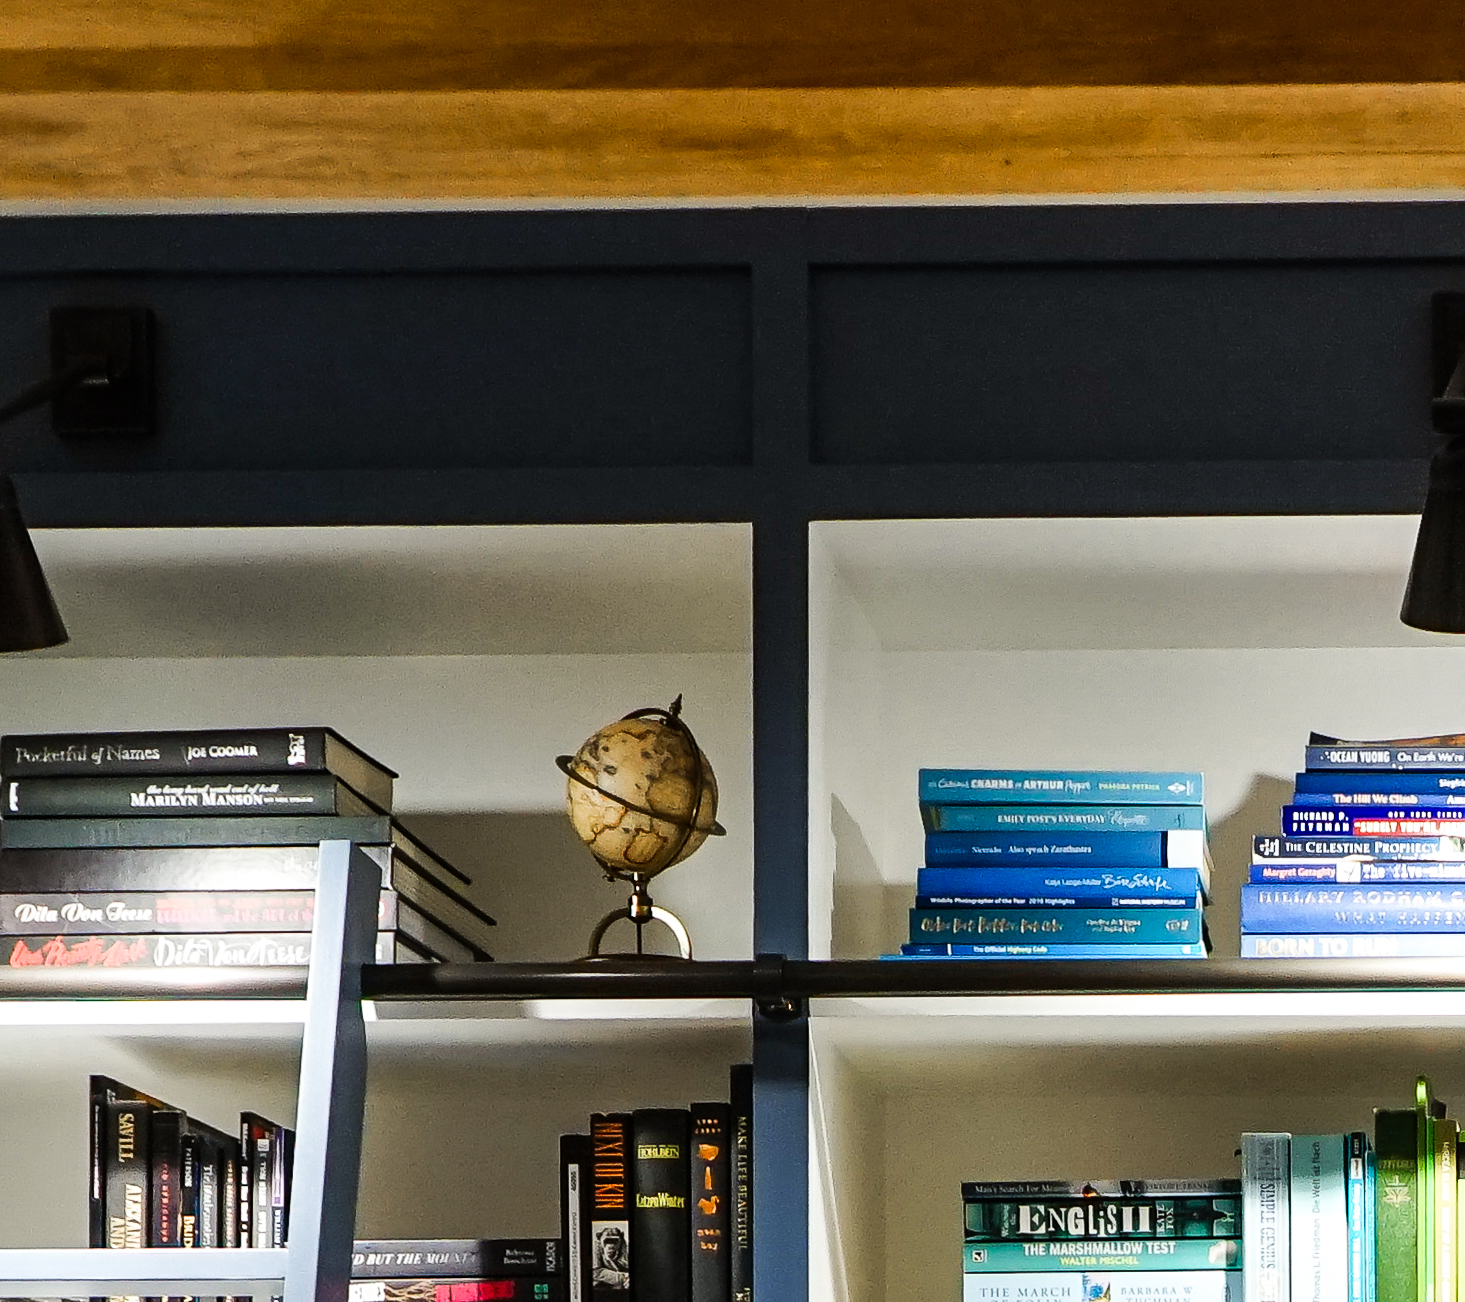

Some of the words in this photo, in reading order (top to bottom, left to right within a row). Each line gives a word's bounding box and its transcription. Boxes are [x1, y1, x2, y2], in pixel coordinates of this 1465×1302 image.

[1330, 751, 1357, 763] OCEAN
[1360, 751, 1390, 763] VUONG
[1397, 753, 1410, 762] On
[1413, 752, 1435, 762] Earth
[1438, 752, 1465, 762] We're
[131, 793, 197, 806] MARILYN
[202, 793, 263, 806] MANSON
[1286, 842, 1302, 851] THE
[1306, 841, 1369, 853] CELESTINE
[1374, 841, 1438, 853] PROPHECY
[1023, 1244, 1046, 1256] THE
[1050, 1242, 1143, 1255] MARSHMALLOW
[1147, 1242, 1175, 1254] TEST
